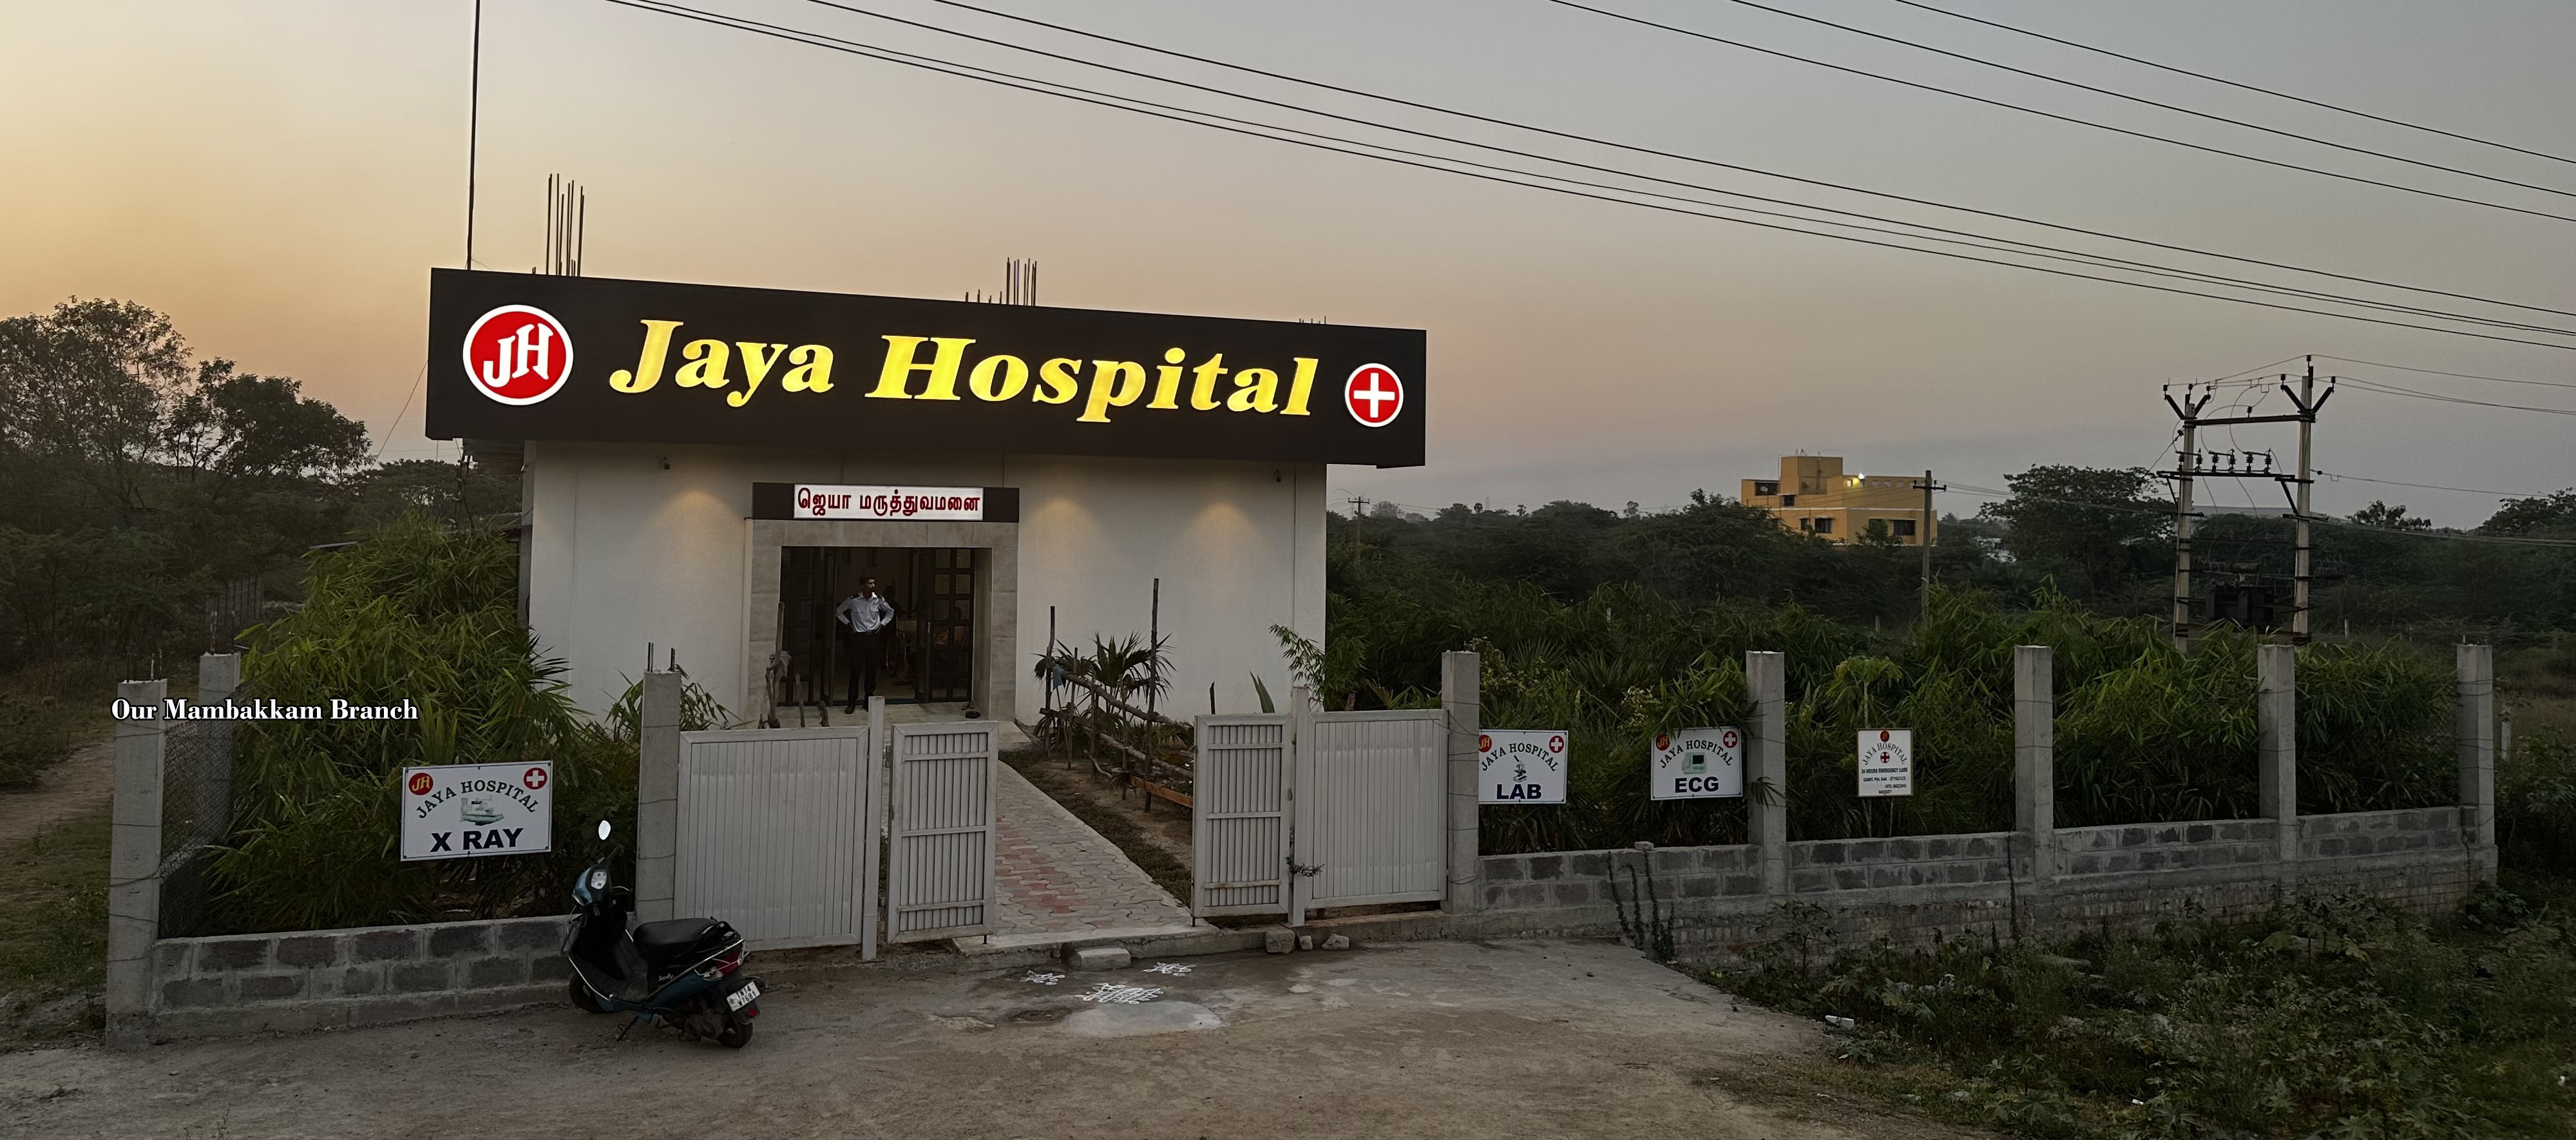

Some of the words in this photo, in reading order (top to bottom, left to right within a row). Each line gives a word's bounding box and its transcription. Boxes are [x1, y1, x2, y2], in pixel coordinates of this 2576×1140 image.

[482, 322, 555, 388] JH
[609, 319, 835, 407] Jaya
[864, 334, 1319, 423] Hospital
[797, 487, 852, 516] ஜெயா
[860, 488, 980, 516] மருத்துவமனை
[1482, 747, 1507, 771] JAYA
[1509, 742, 1558, 771] HOSPITAL
[1660, 744, 1684, 768] JAYA
[1686, 739, 1733, 766] HOSPITAL
[1862, 747, 1877, 766] JAYA
[1876, 742, 1907, 765] HOSPITAL
[416, 786, 457, 818] JAYA
[461, 779, 539, 813] HOSPITAL
[1496, 784, 1541, 799] LAB
[1675, 777, 1719, 793] ECG
[430, 831, 452, 852] X
[463, 827, 524, 850] RAY
